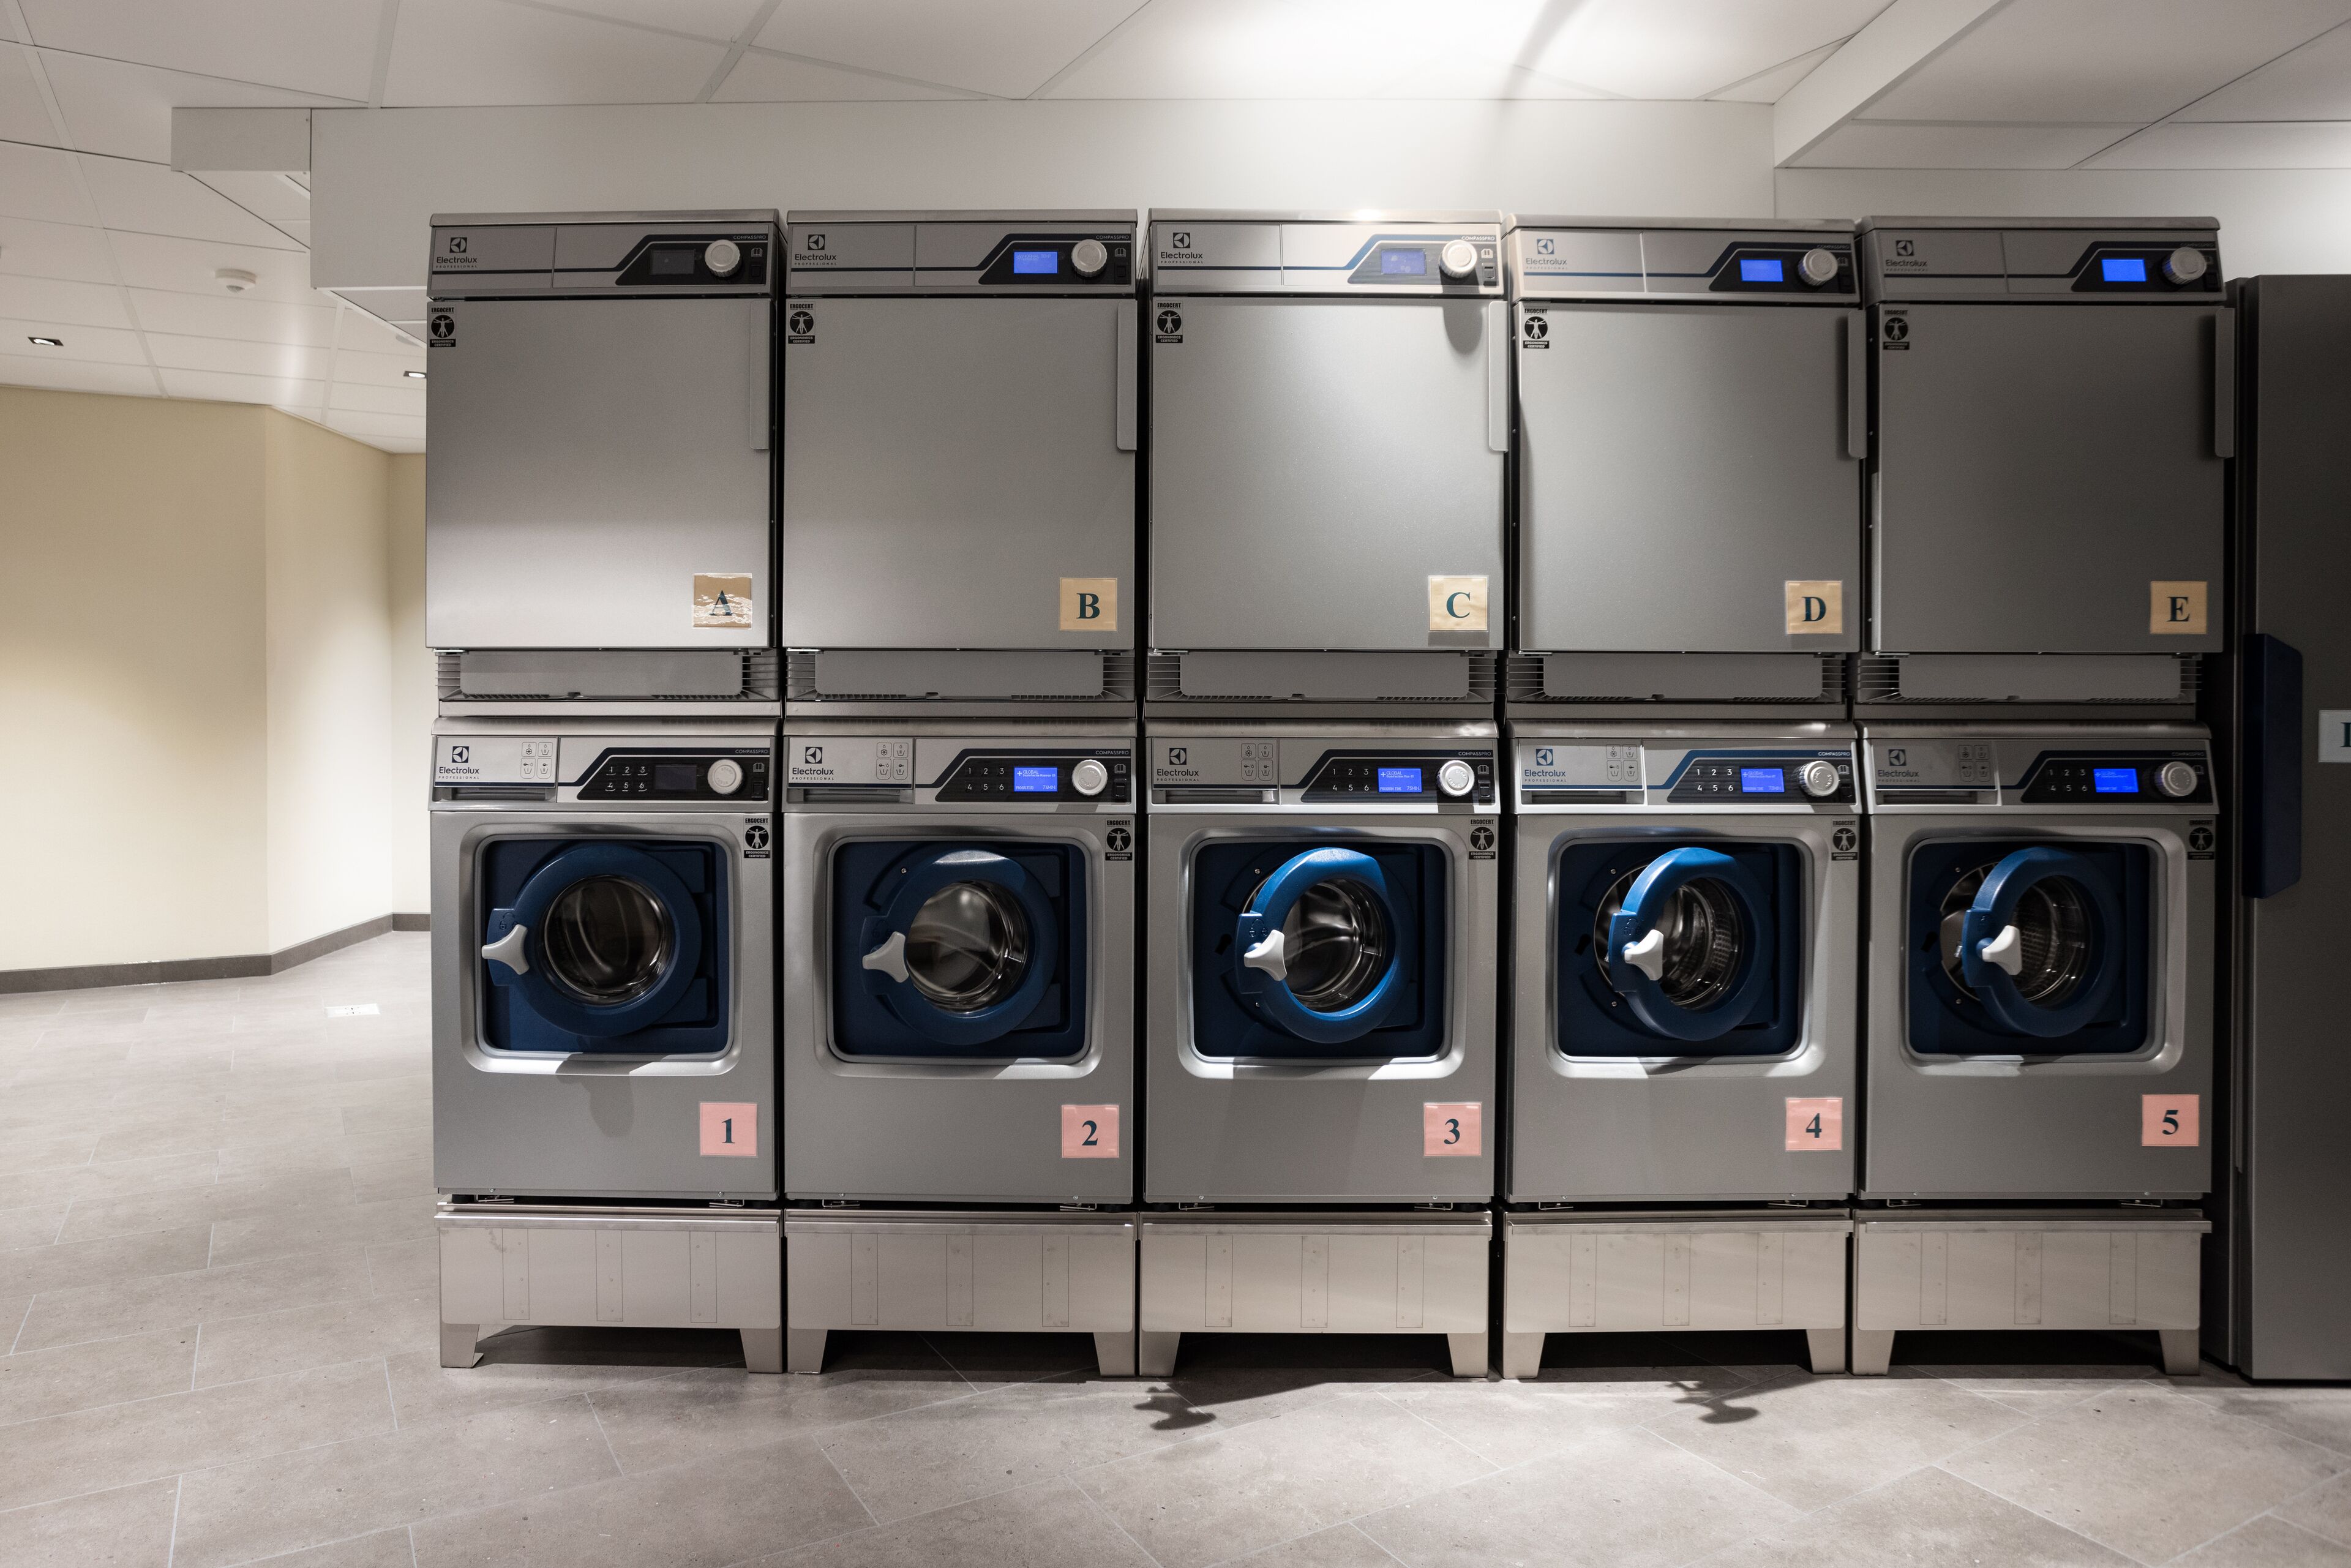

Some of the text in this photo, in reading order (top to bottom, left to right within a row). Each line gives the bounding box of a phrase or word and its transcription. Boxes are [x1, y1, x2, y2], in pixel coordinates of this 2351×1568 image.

[709, 590, 733, 616] A
[1076, 593, 1100, 619] B
[1446, 591, 1471, 618] C
[1802, 596, 1826, 622] D
[2166, 596, 2190, 622] E
[721, 1118, 735, 1144] 1
[1082, 1120, 1098, 1146] 2
[1444, 1118, 1460, 1144] 3
[1805, 1112, 1822, 1138] 4
[2162, 1109, 2179, 1135] 5
